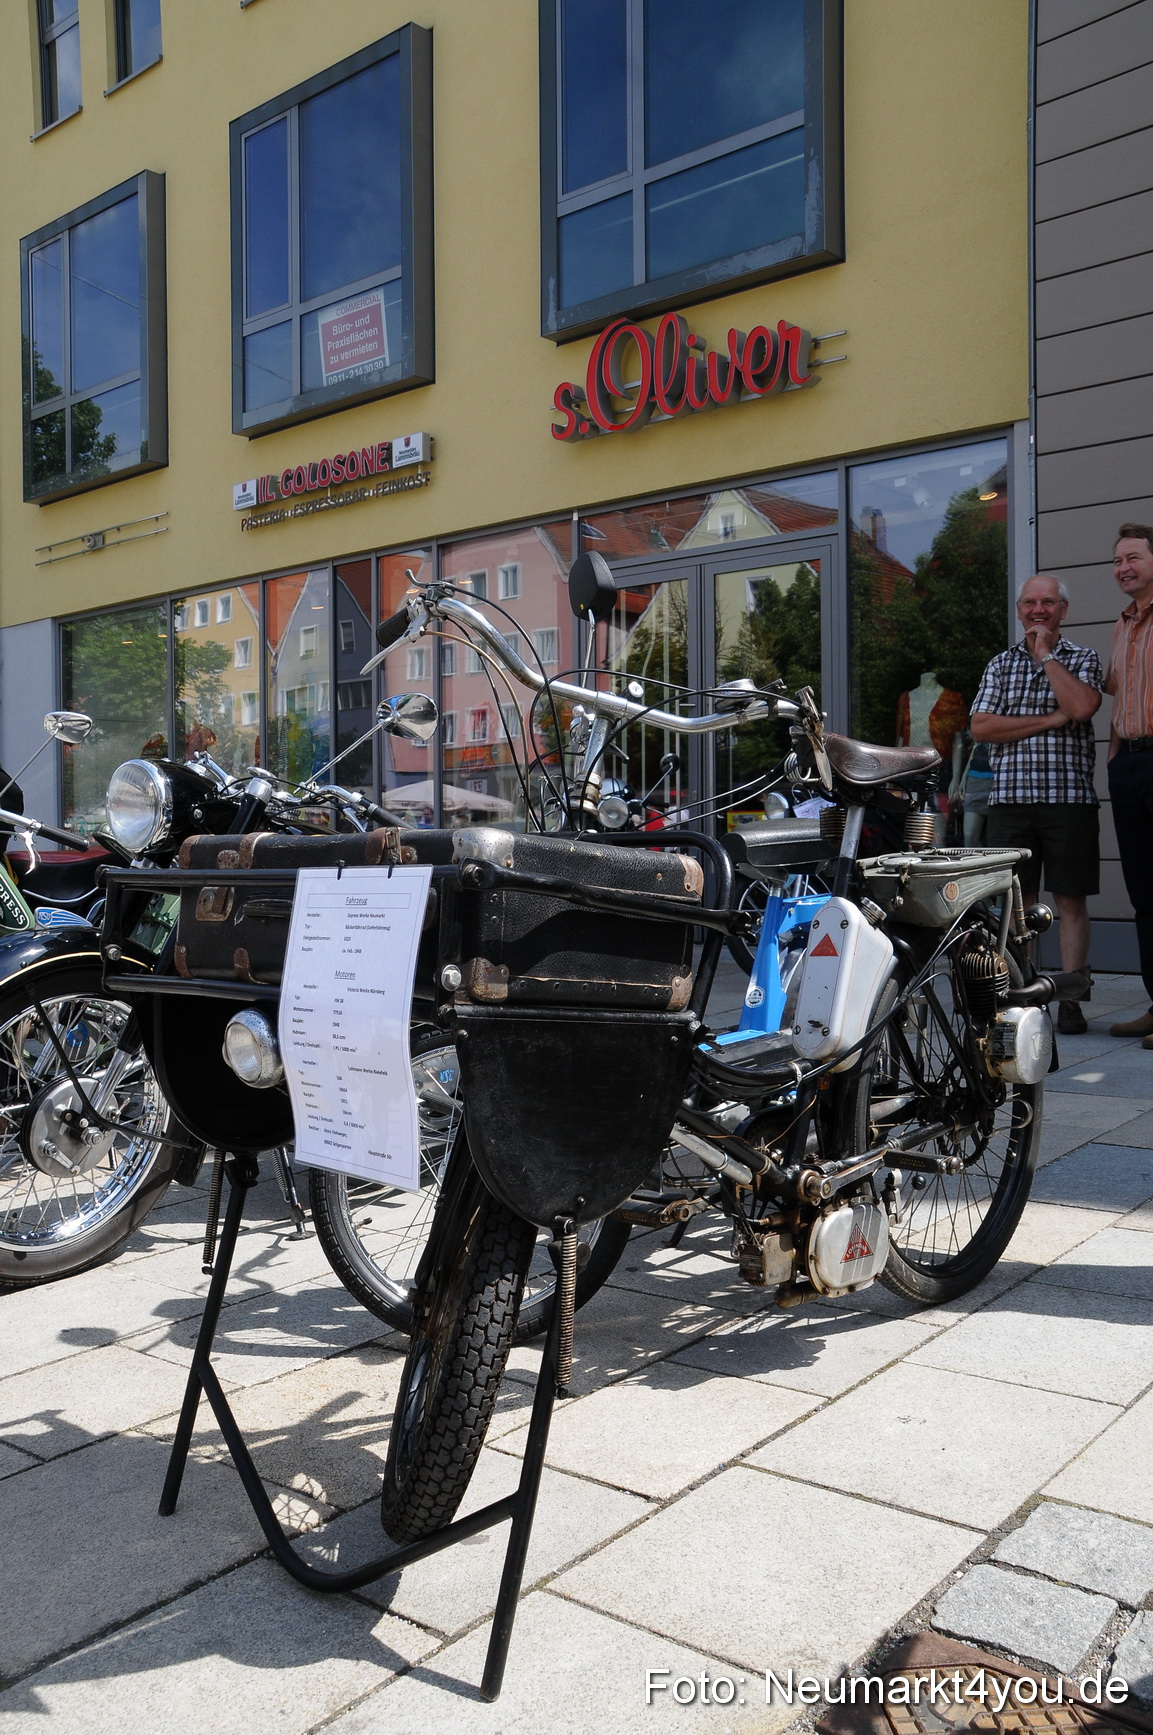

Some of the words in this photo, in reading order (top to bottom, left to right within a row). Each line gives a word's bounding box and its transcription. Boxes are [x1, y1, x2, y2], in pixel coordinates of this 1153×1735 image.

[336, 294, 381, 316] COMMERCIAL
[332, 323, 353, 336] Büro-
[354, 314, 370, 328] und
[327, 327, 378, 352] Praxisflächen
[330, 355, 339, 364] zu
[340, 341, 378, 360] vermieten
[551, 312, 814, 441] s.Oliver
[258, 474, 276, 503] IL
[280, 442, 390, 496] GOLOSONE
[241, 507, 286, 532] PASTERIA
[294, 486, 366, 518] ESPRESSOBAR
[375, 471, 431, 498] FEINKOST
[345, 896, 368, 905] Fahrzeug
[335, 970, 356, 980] Motoren
